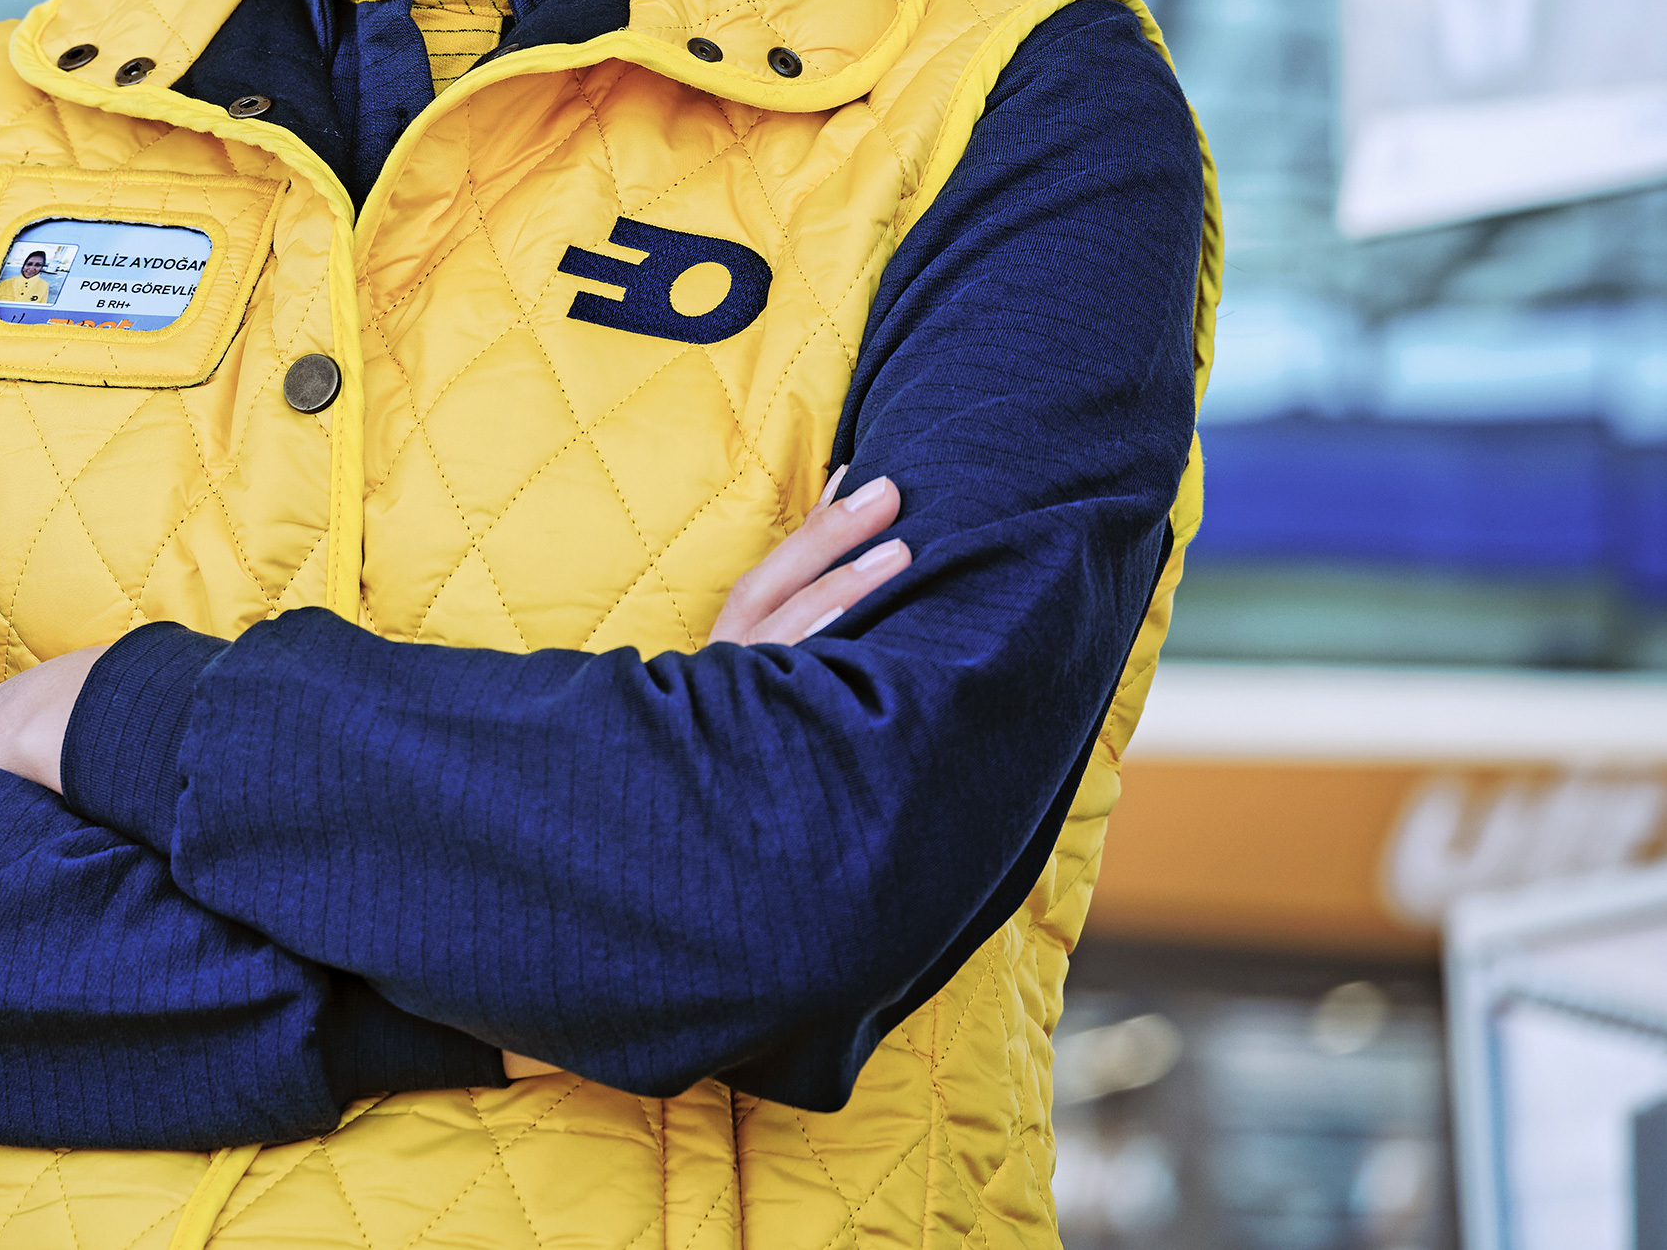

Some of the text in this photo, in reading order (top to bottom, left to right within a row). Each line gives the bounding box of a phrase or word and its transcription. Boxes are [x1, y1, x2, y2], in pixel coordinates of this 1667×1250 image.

[83, 253, 128, 267] YELİZ
[80, 280, 128, 293] POMPA
[96, 299, 131, 309] B RH+
